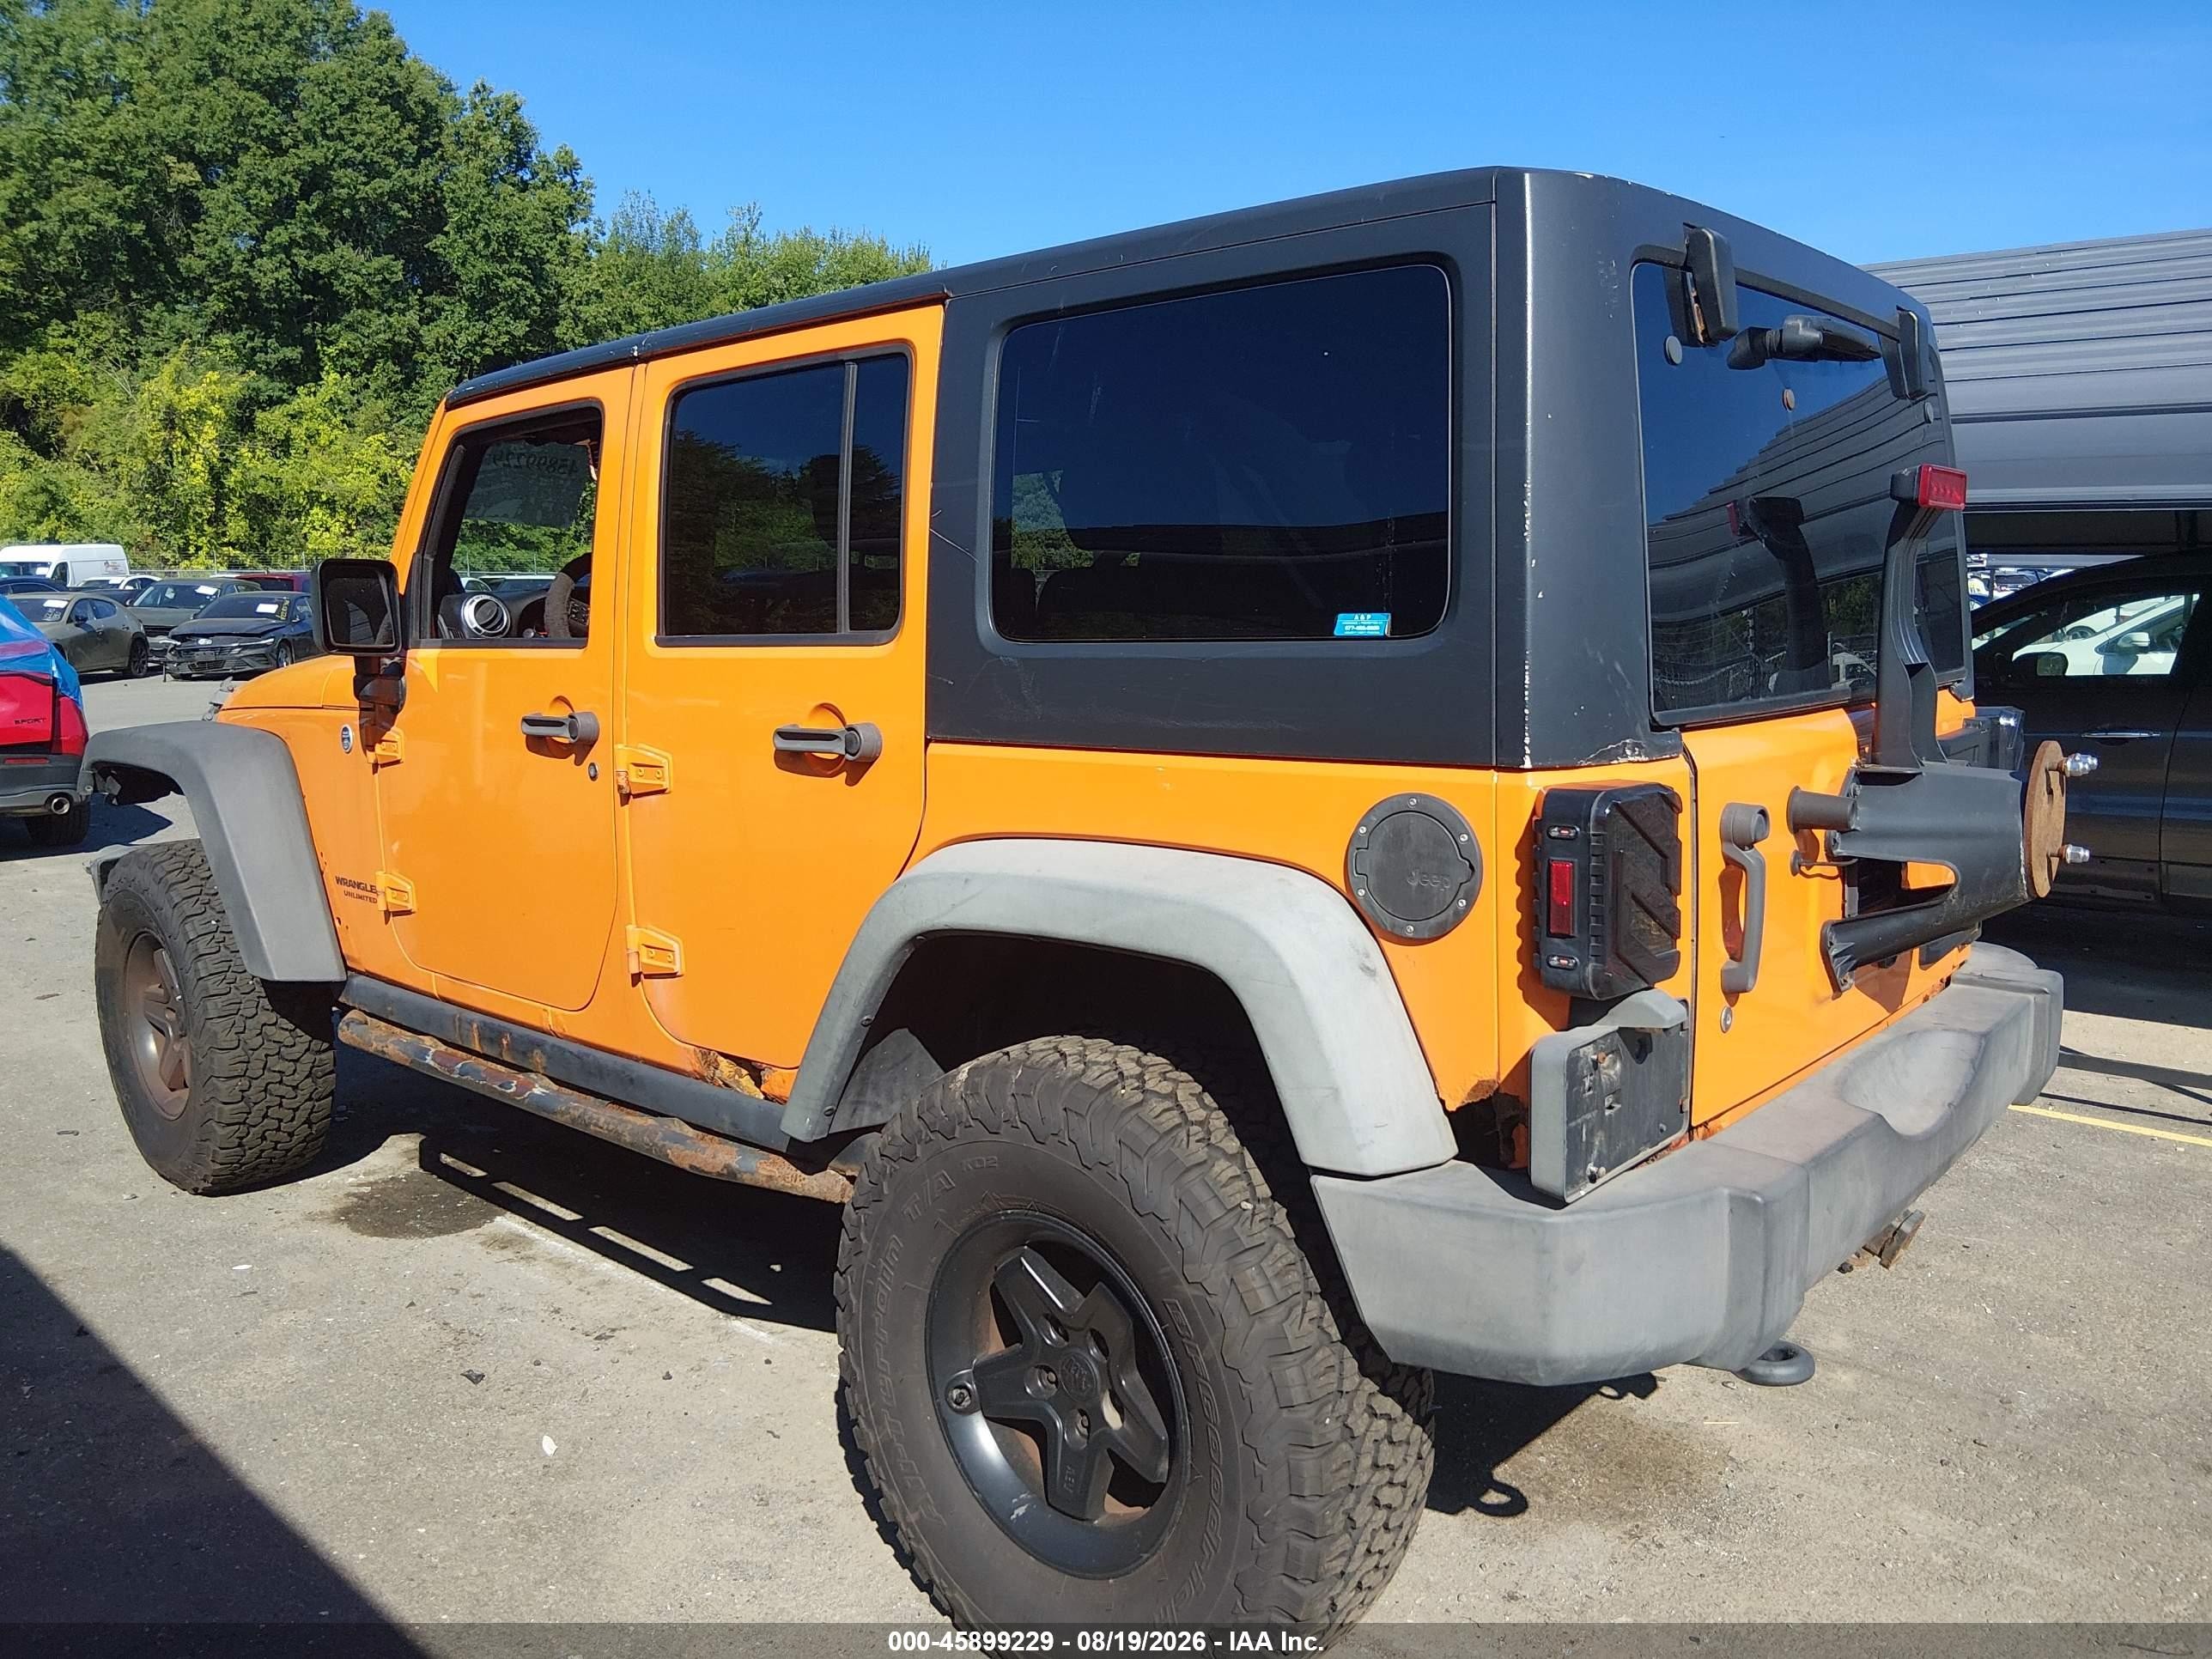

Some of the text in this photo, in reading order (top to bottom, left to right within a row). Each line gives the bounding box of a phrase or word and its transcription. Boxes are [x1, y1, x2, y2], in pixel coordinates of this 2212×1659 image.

[335, 876, 379, 896] WRANGLE
[1406, 868, 1451, 892] Jeep
[343, 890, 379, 904] UNLIMITED
